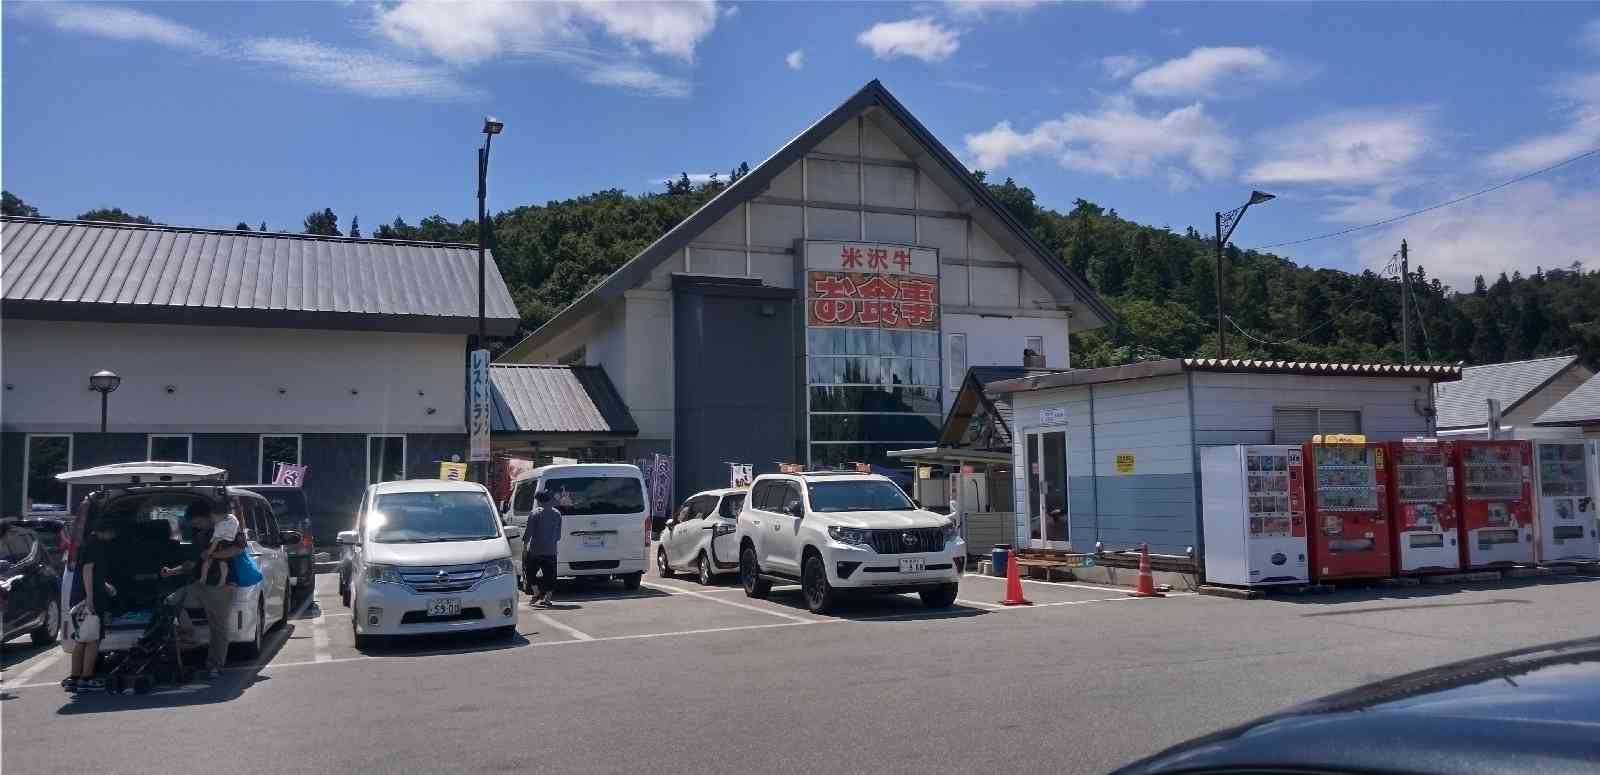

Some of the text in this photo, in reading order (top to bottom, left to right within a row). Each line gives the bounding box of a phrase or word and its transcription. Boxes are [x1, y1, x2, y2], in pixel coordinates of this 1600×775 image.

[841, 246, 910, 271] 米沢牛
[815, 276, 935, 325] お食事
[472, 352, 482, 435] レストラン
